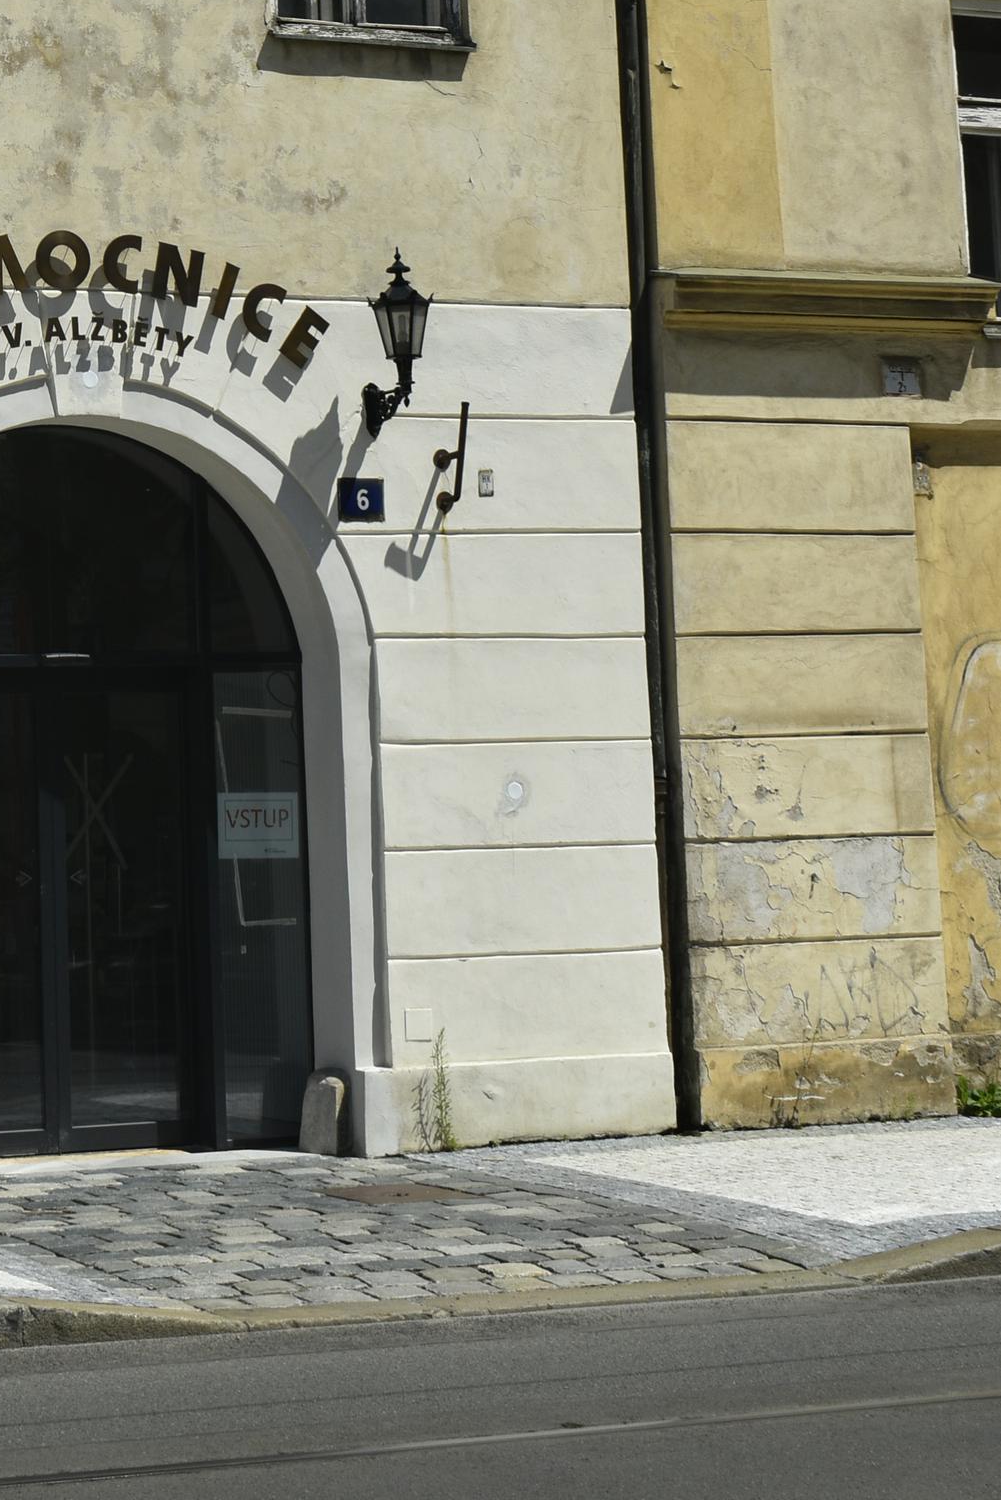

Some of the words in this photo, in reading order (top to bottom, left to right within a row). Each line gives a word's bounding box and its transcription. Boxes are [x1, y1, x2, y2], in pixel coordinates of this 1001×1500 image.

[45, 309, 194, 357] ALŽBĚTY
[356, 488, 370, 511] 6
[225, 808, 289, 828] VSTUP
